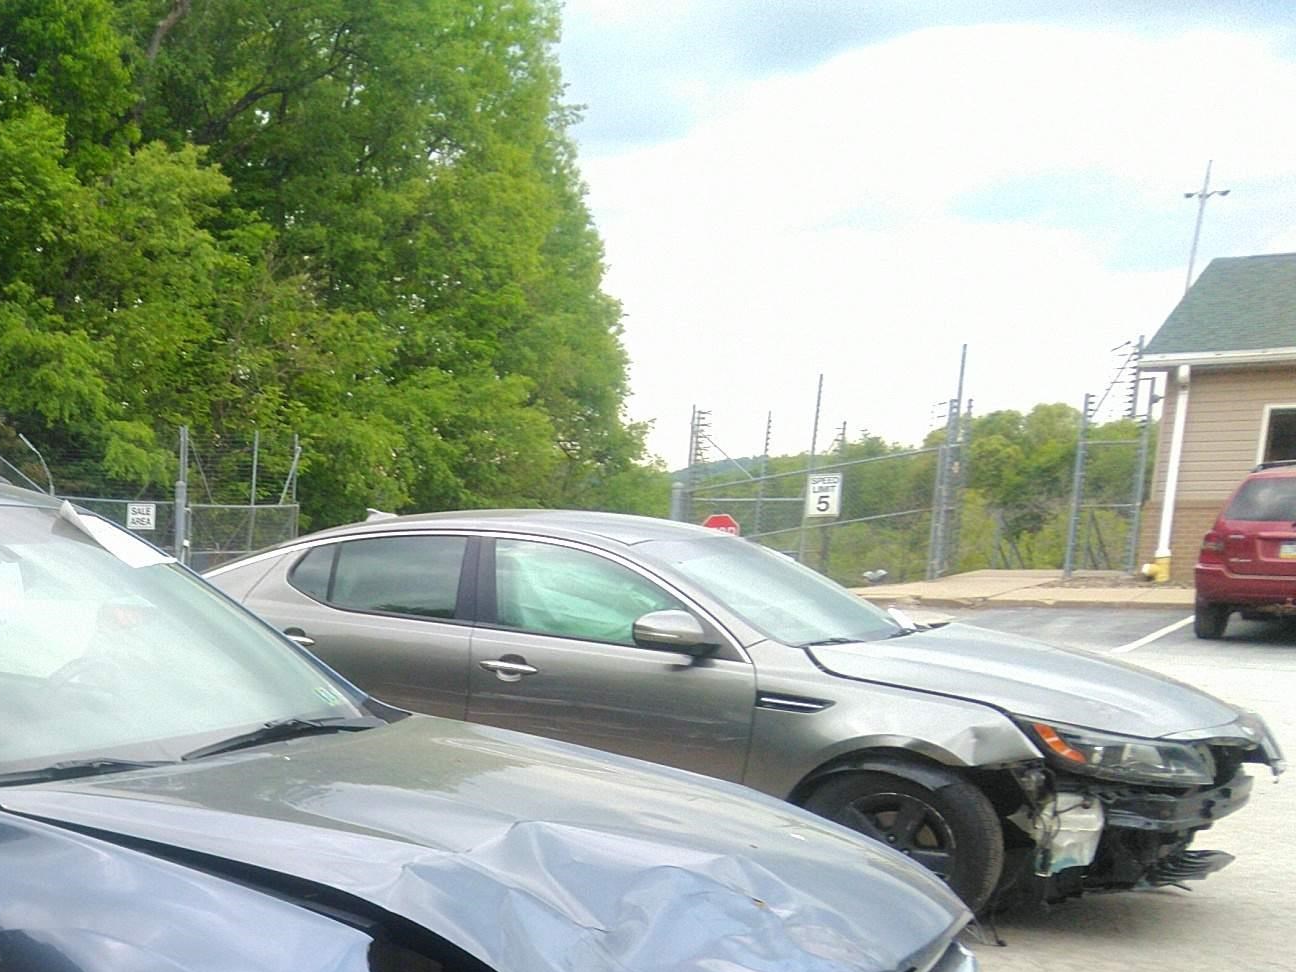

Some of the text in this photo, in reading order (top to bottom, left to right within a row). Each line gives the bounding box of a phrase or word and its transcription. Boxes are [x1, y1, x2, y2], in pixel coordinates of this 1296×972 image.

[810, 476, 839, 485] SPEED
[812, 485, 837, 494] LIMIT
[816, 495, 830, 512] 5
[130, 507, 151, 516] SALE
[130, 517, 152, 526] AREA
